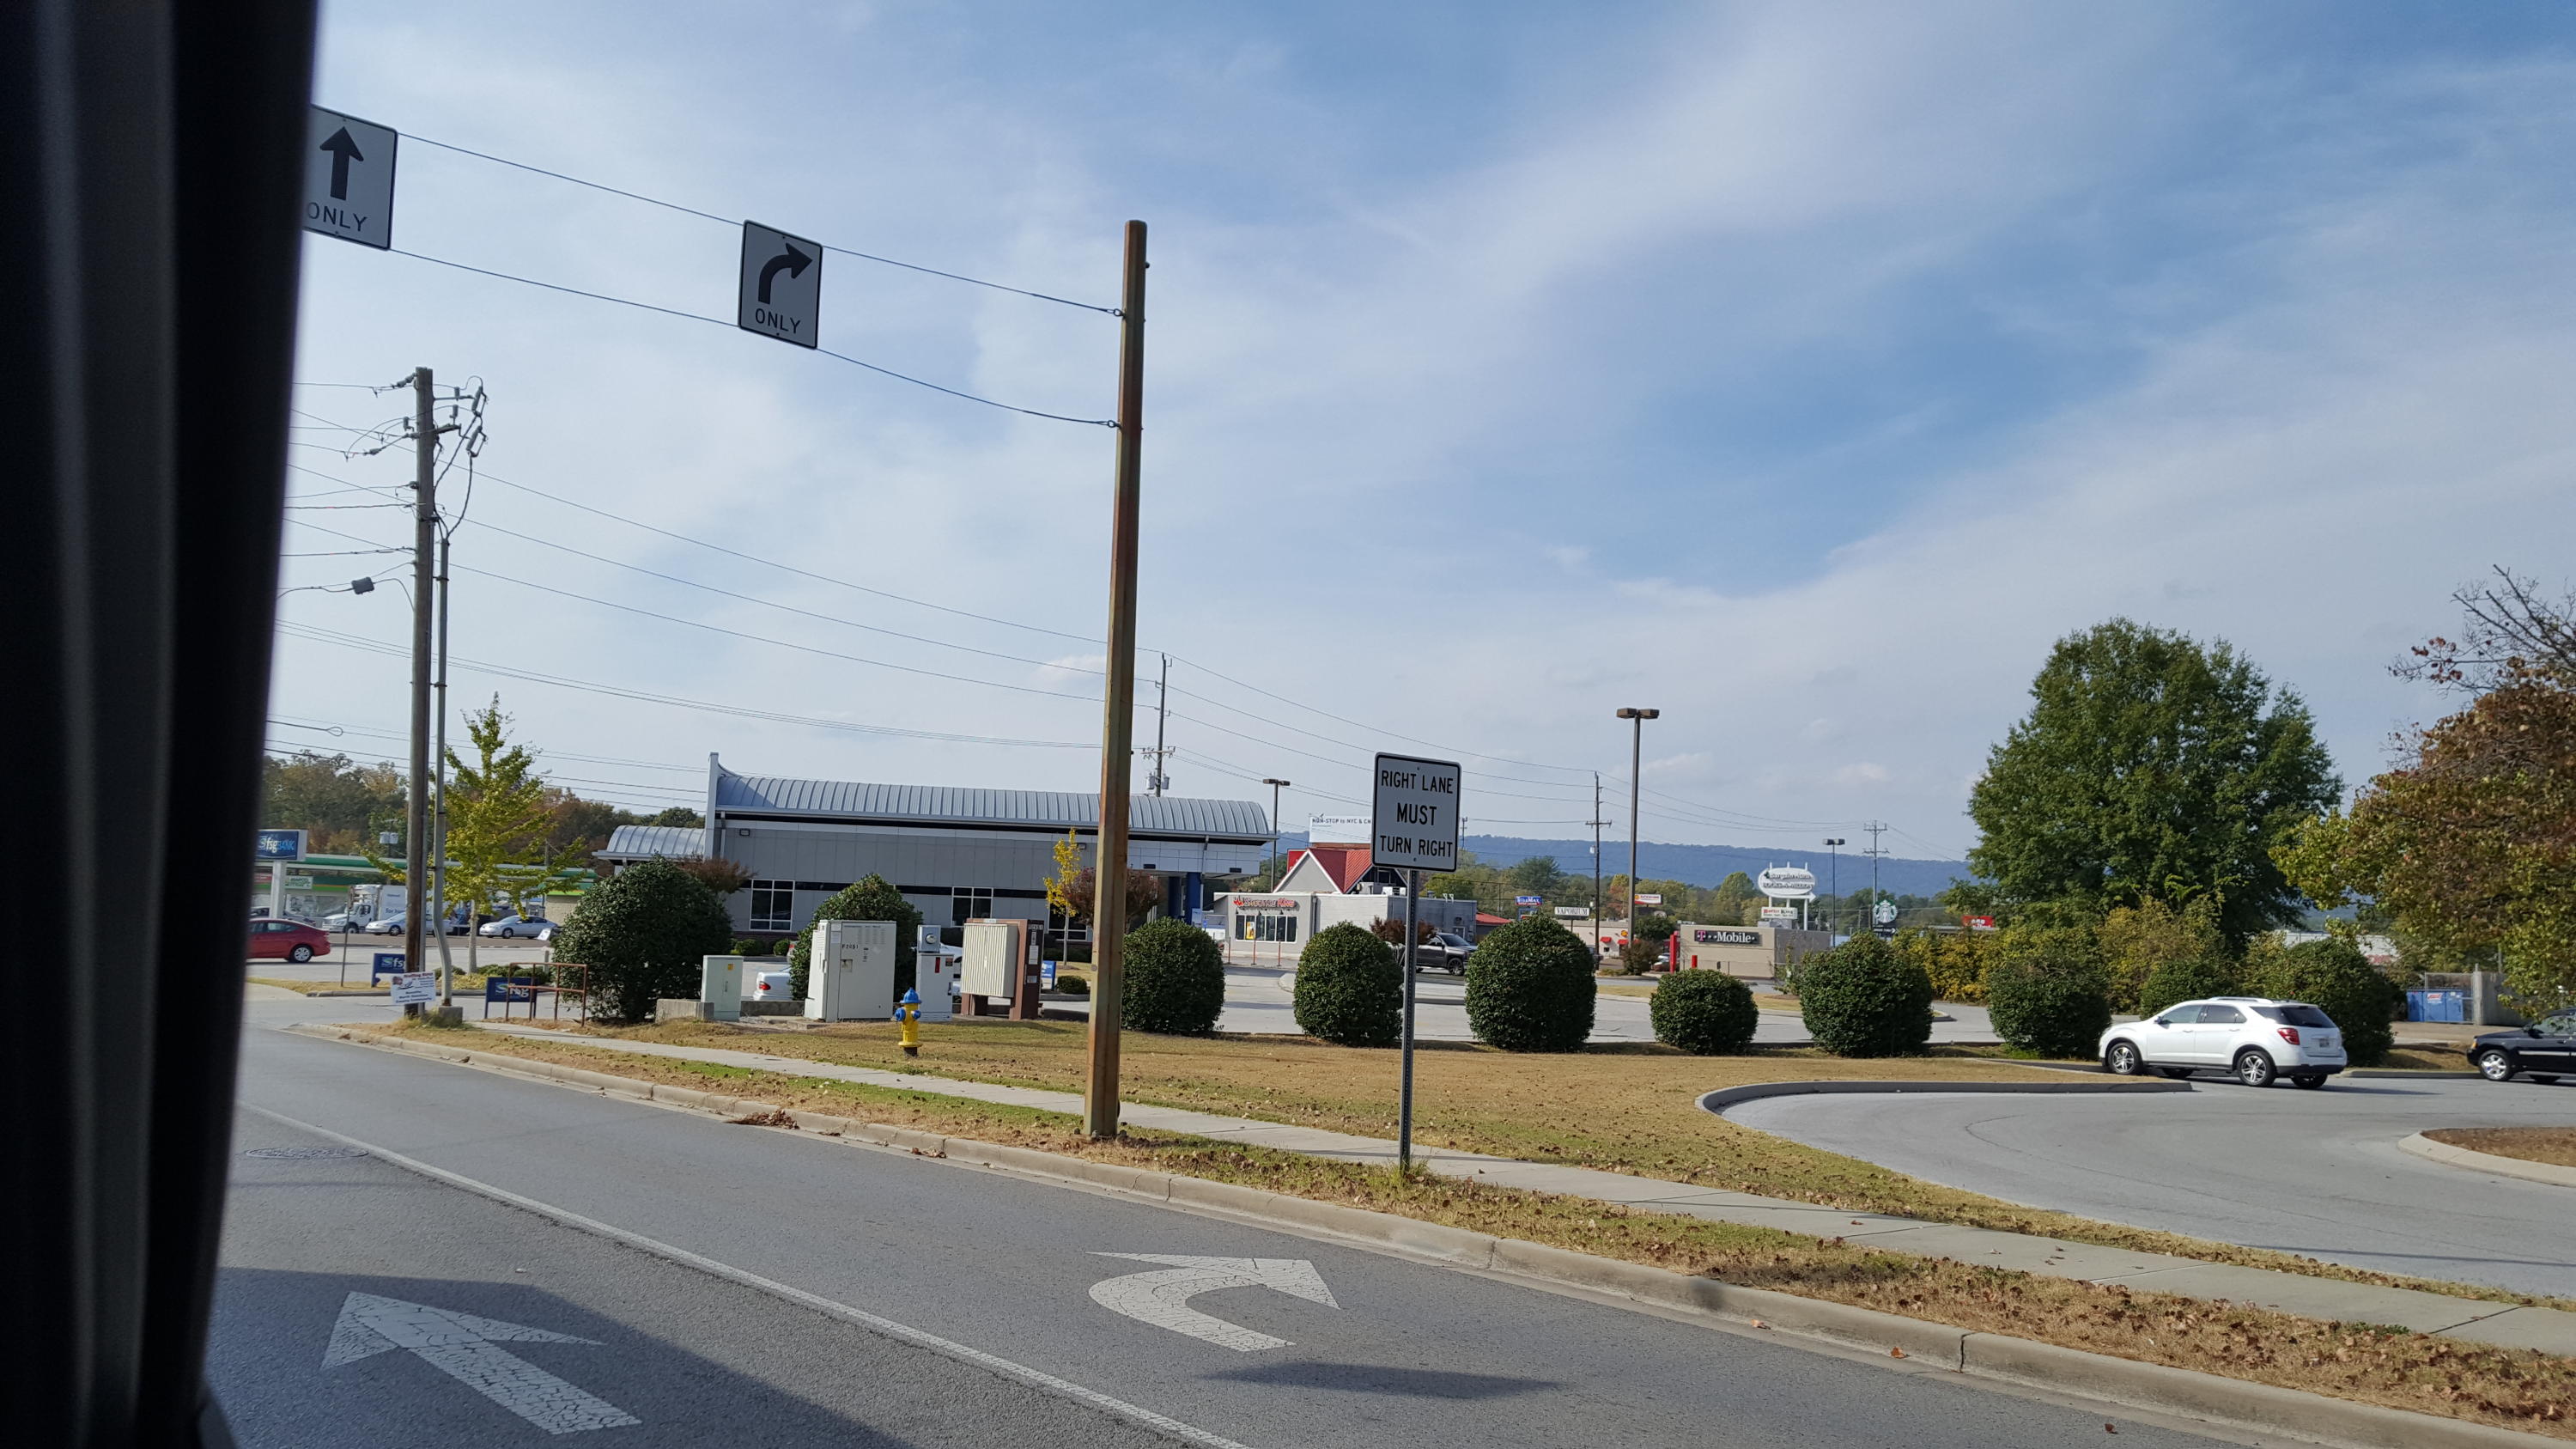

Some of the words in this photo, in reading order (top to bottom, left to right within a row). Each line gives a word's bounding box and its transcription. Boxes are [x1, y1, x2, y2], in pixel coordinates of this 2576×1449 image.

[307, 201, 368, 232] ONLY
[755, 307, 801, 334] ONLY
[1381, 770, 1417, 789] RIGHT
[1421, 774, 1454, 795] LANE
[1396, 802, 1437, 826] MUST
[1380, 835, 1412, 854] TURN
[1418, 838, 1454, 858] RIGHT
